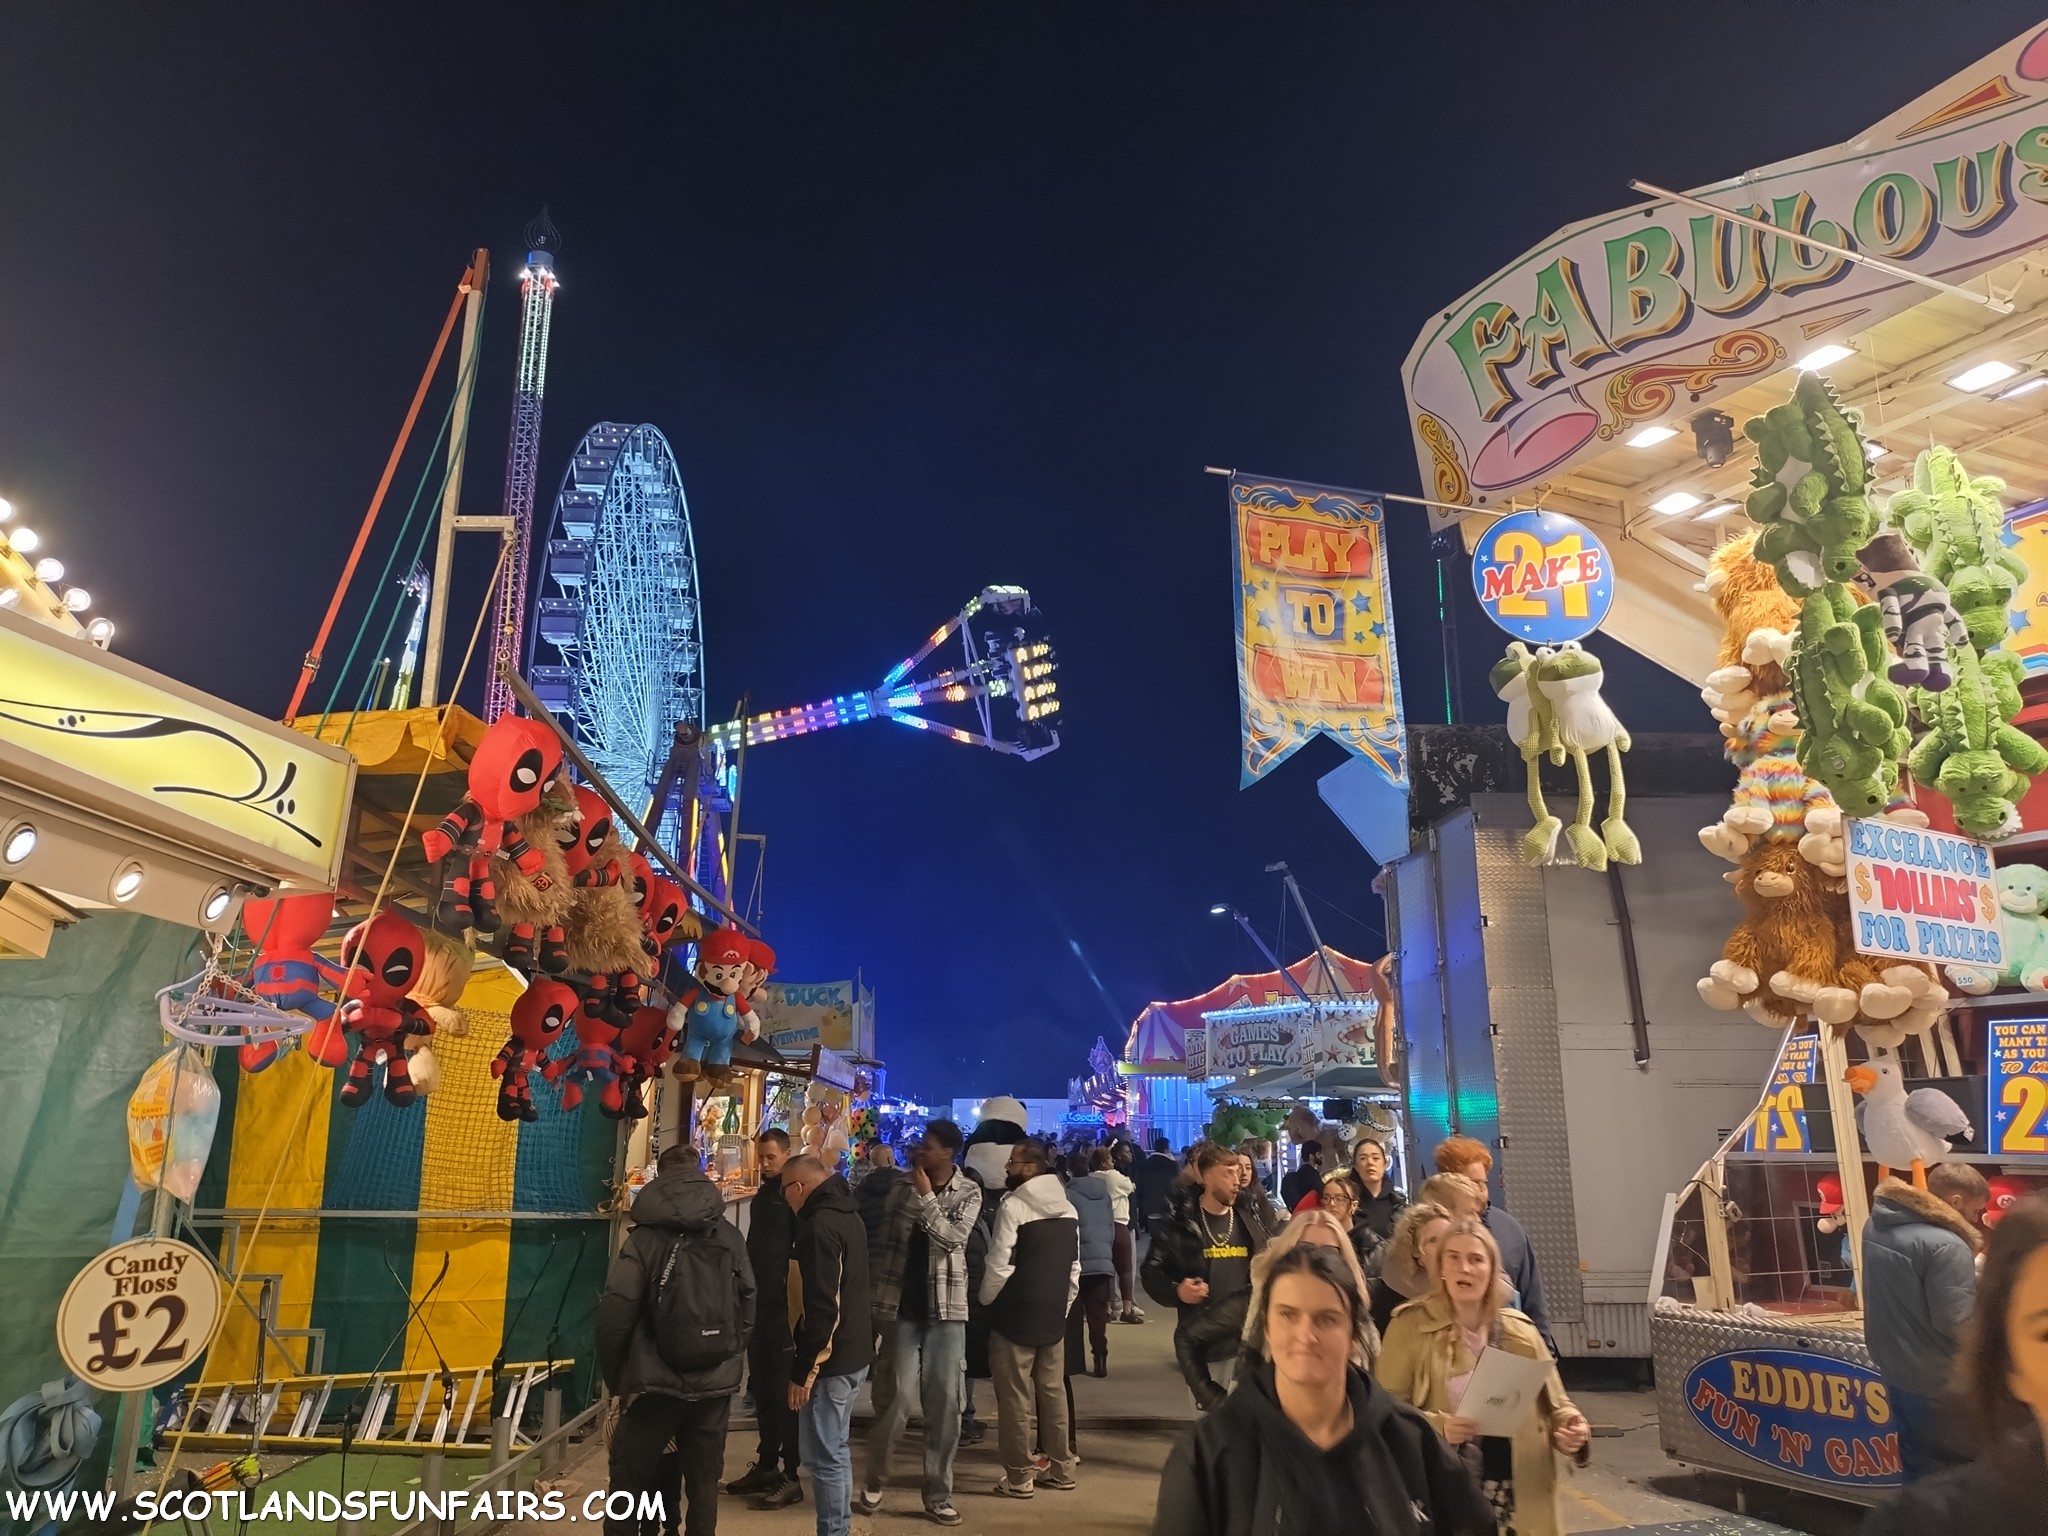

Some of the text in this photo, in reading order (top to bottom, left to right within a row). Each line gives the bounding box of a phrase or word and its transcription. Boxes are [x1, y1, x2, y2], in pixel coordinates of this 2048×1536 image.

[1259, 519, 1356, 573] PLAY
[1482, 548, 1602, 602] MAKE
[1493, 530, 1590, 619] 21
[1285, 589, 1335, 636] TO
[1278, 657, 1357, 703] WIN
[1848, 820, 1991, 879] EXCHANGE
[1858, 911, 2001, 964] FOR PRIZES
[784, 986, 845, 1012] DUCK
[769, 1026, 820, 1046] VERYTIME
[1230, 1022, 1280, 1046] GAMES
[1994, 1024, 2046, 1035] YOU CAN
[1999, 1036, 2033, 1047] MANY
[1188, 1055, 1206, 1071] BIG
[1225, 1043, 1287, 1067] TO PLAY
[2000, 1061, 2024, 1074] TO
[2002, 1048, 2045, 1059] AS YOU
[2001, 1074, 2048, 1153] 2
[105, 1251, 190, 1277] Candy
[112, 1275, 178, 1298] Floss
[86, 1294, 190, 1375] £2
[1729, 1358, 1891, 1426] EDDIE'S
[1692, 1377, 1760, 1447] FUN
[1824, 1431, 1903, 1477] GAM
